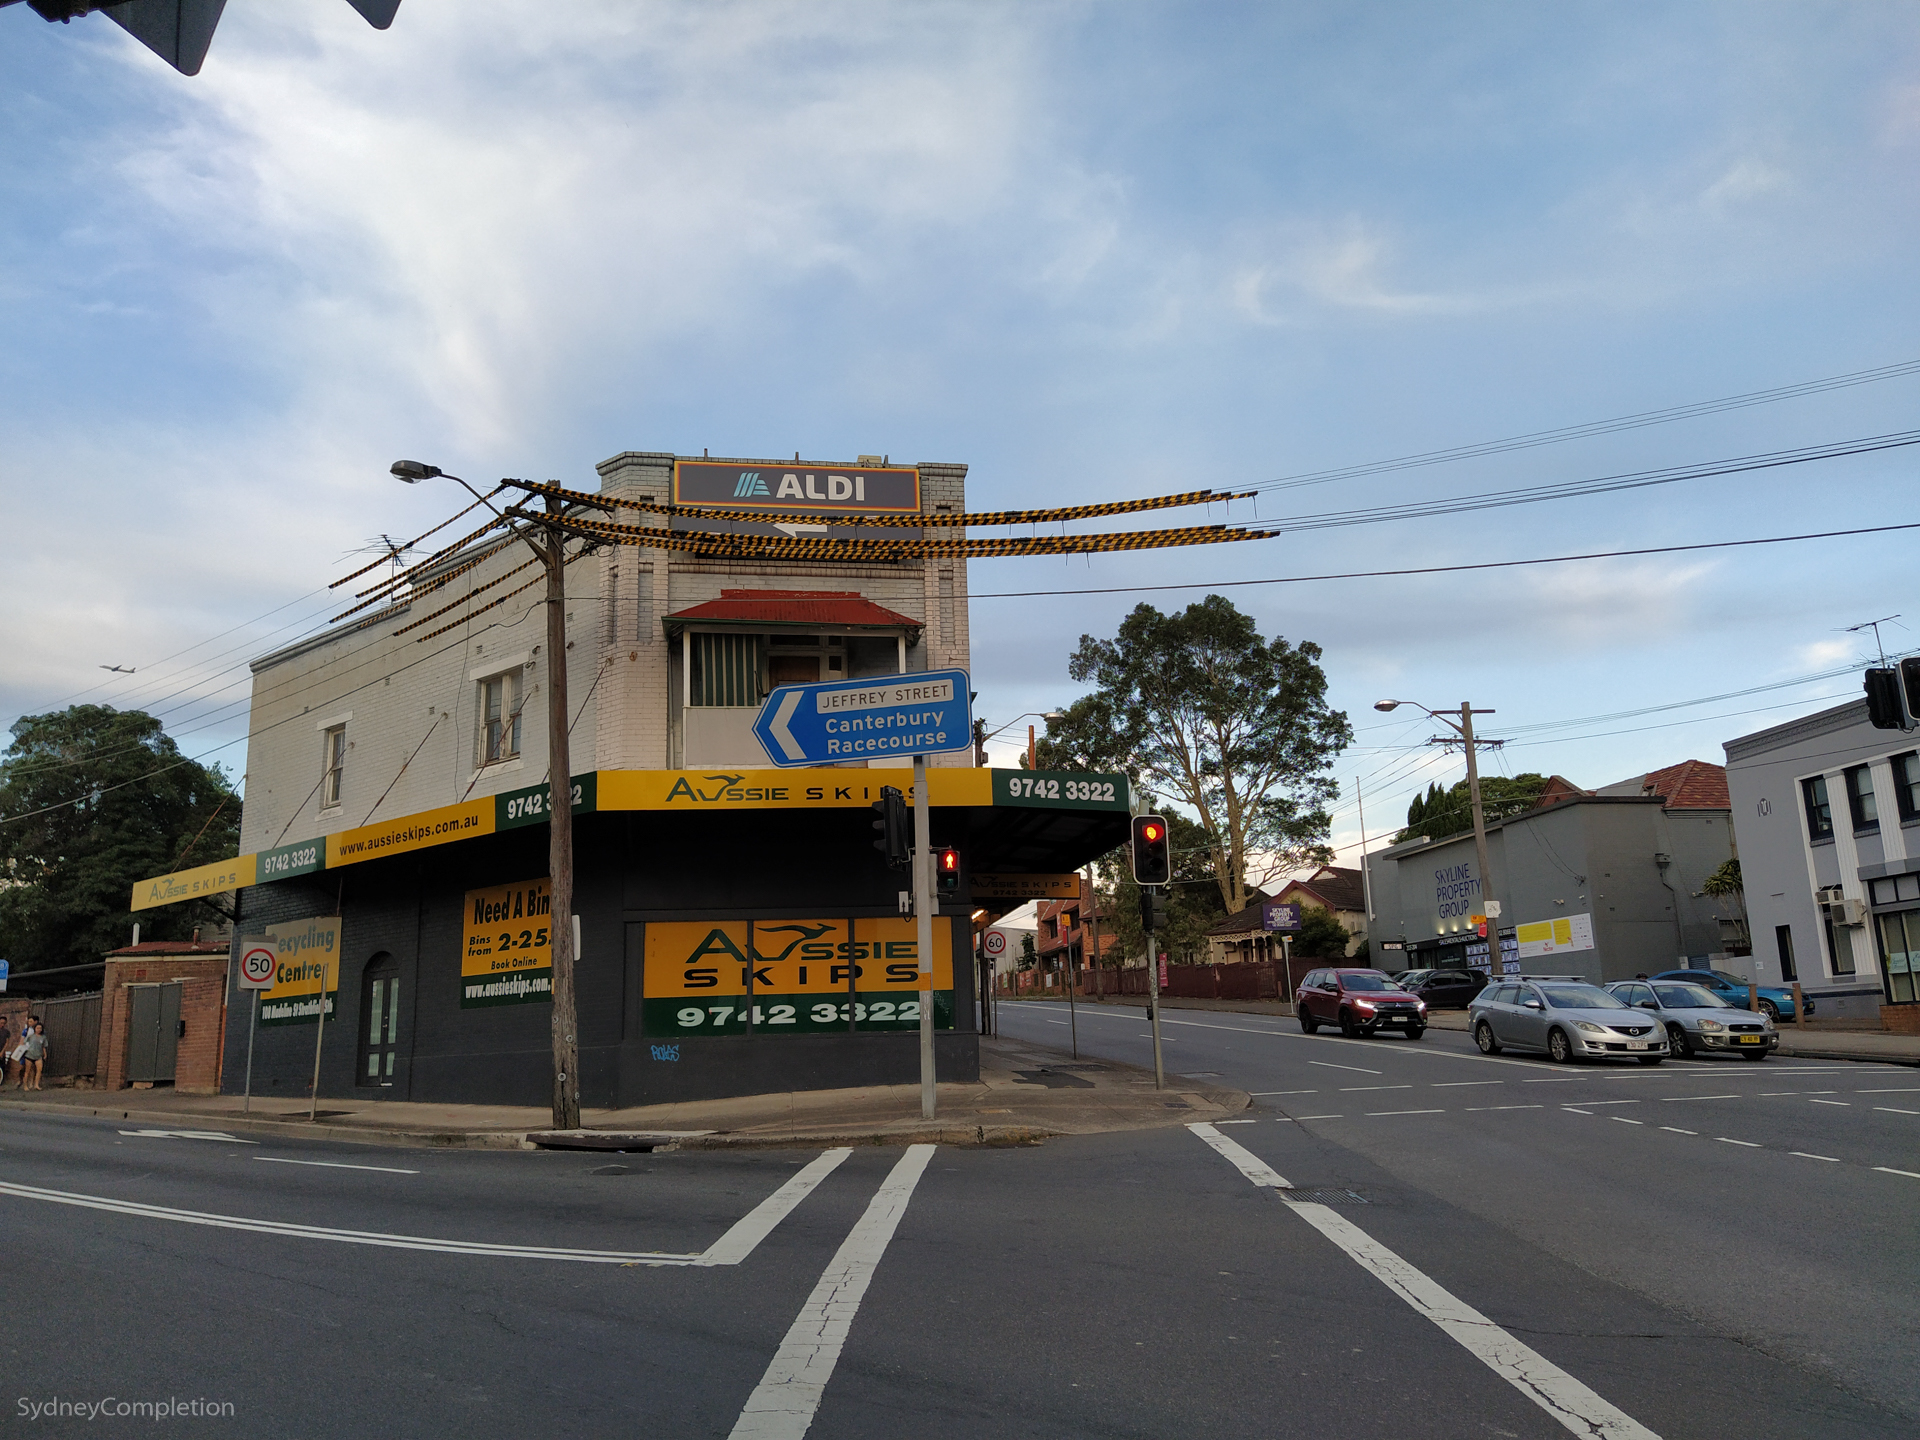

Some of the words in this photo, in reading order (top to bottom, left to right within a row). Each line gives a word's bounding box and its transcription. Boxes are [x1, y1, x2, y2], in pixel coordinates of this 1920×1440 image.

[776, 473, 865, 501] ALDI
[822, 691, 887, 709] JEFFREY
[895, 684, 949, 702] STREET
[825, 711, 945, 734] Canterbury
[827, 731, 948, 755] Racecourse
[1009, 778, 1060, 799] 9742
[1065, 781, 1116, 802] 3322
[507, 793, 543, 820] 9742
[339, 814, 479, 857] www.aussieskips.com.au
[264, 853, 289, 874] 9742
[291, 847, 316, 868] 3322
[192, 873, 237, 892] SKIPS
[1435, 863, 1470, 885] SKYLINE
[1436, 878, 1481, 903] PROPERTY
[474, 891, 511, 925] Need
[513, 891, 523, 919] A
[527, 885, 550, 917] Bin
[1438, 900, 1470, 919] GROUP
[468, 946, 492, 957] from
[469, 935, 491, 946] Bins
[987, 938, 1003, 949] 60
[249, 958, 270, 973] 50
[277, 960, 322, 984] Centre
[491, 958, 510, 970] Book
[512, 956, 538, 967] Online
[683, 964, 919, 988] SKIPS
[677, 1004, 797, 1028] 9742
[810, 1001, 921, 1023] 3322
